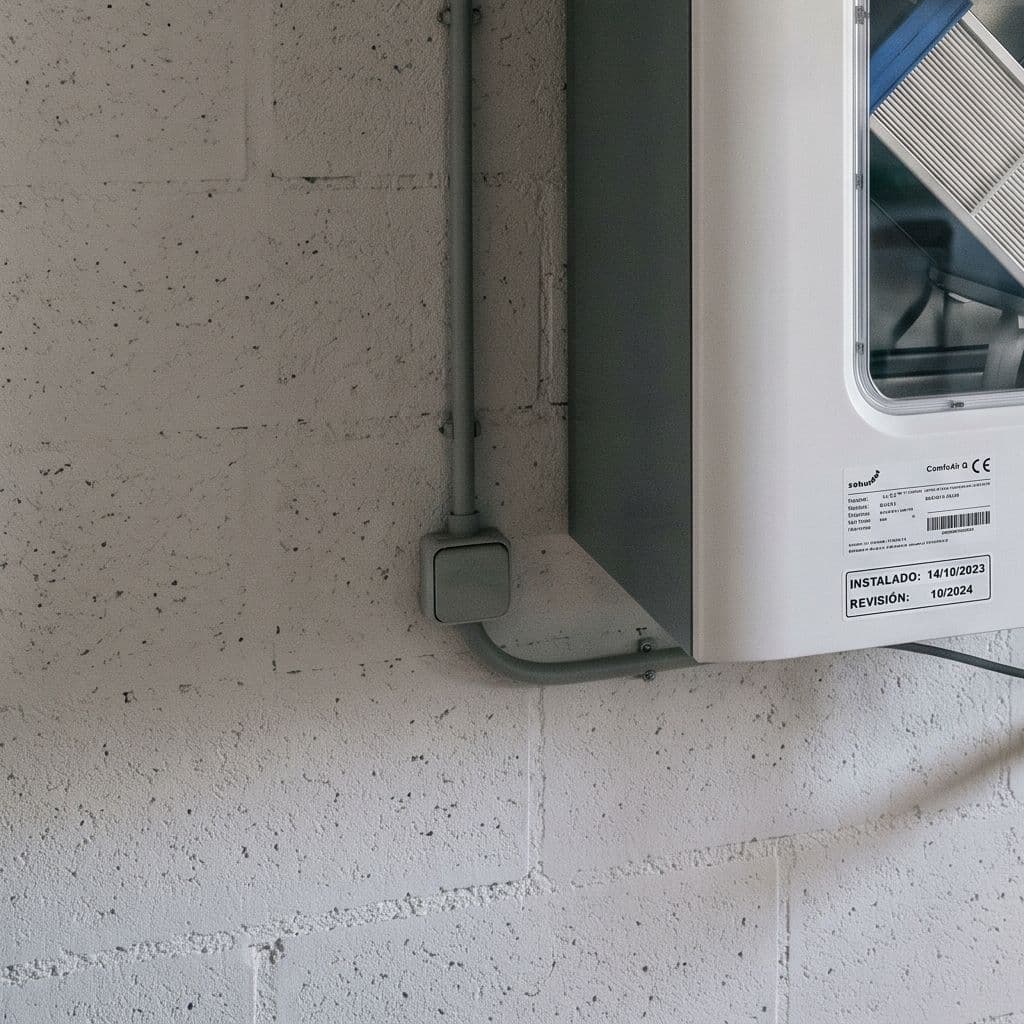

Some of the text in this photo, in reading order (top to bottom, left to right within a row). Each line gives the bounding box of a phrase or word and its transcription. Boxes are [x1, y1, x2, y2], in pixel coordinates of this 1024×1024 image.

[926, 463, 960, 473] ComfoAir
[850, 564, 985, 589] INSTALADO: 14/10/2023
[850, 585, 973, 609] REVISIÓN: 10/2024
